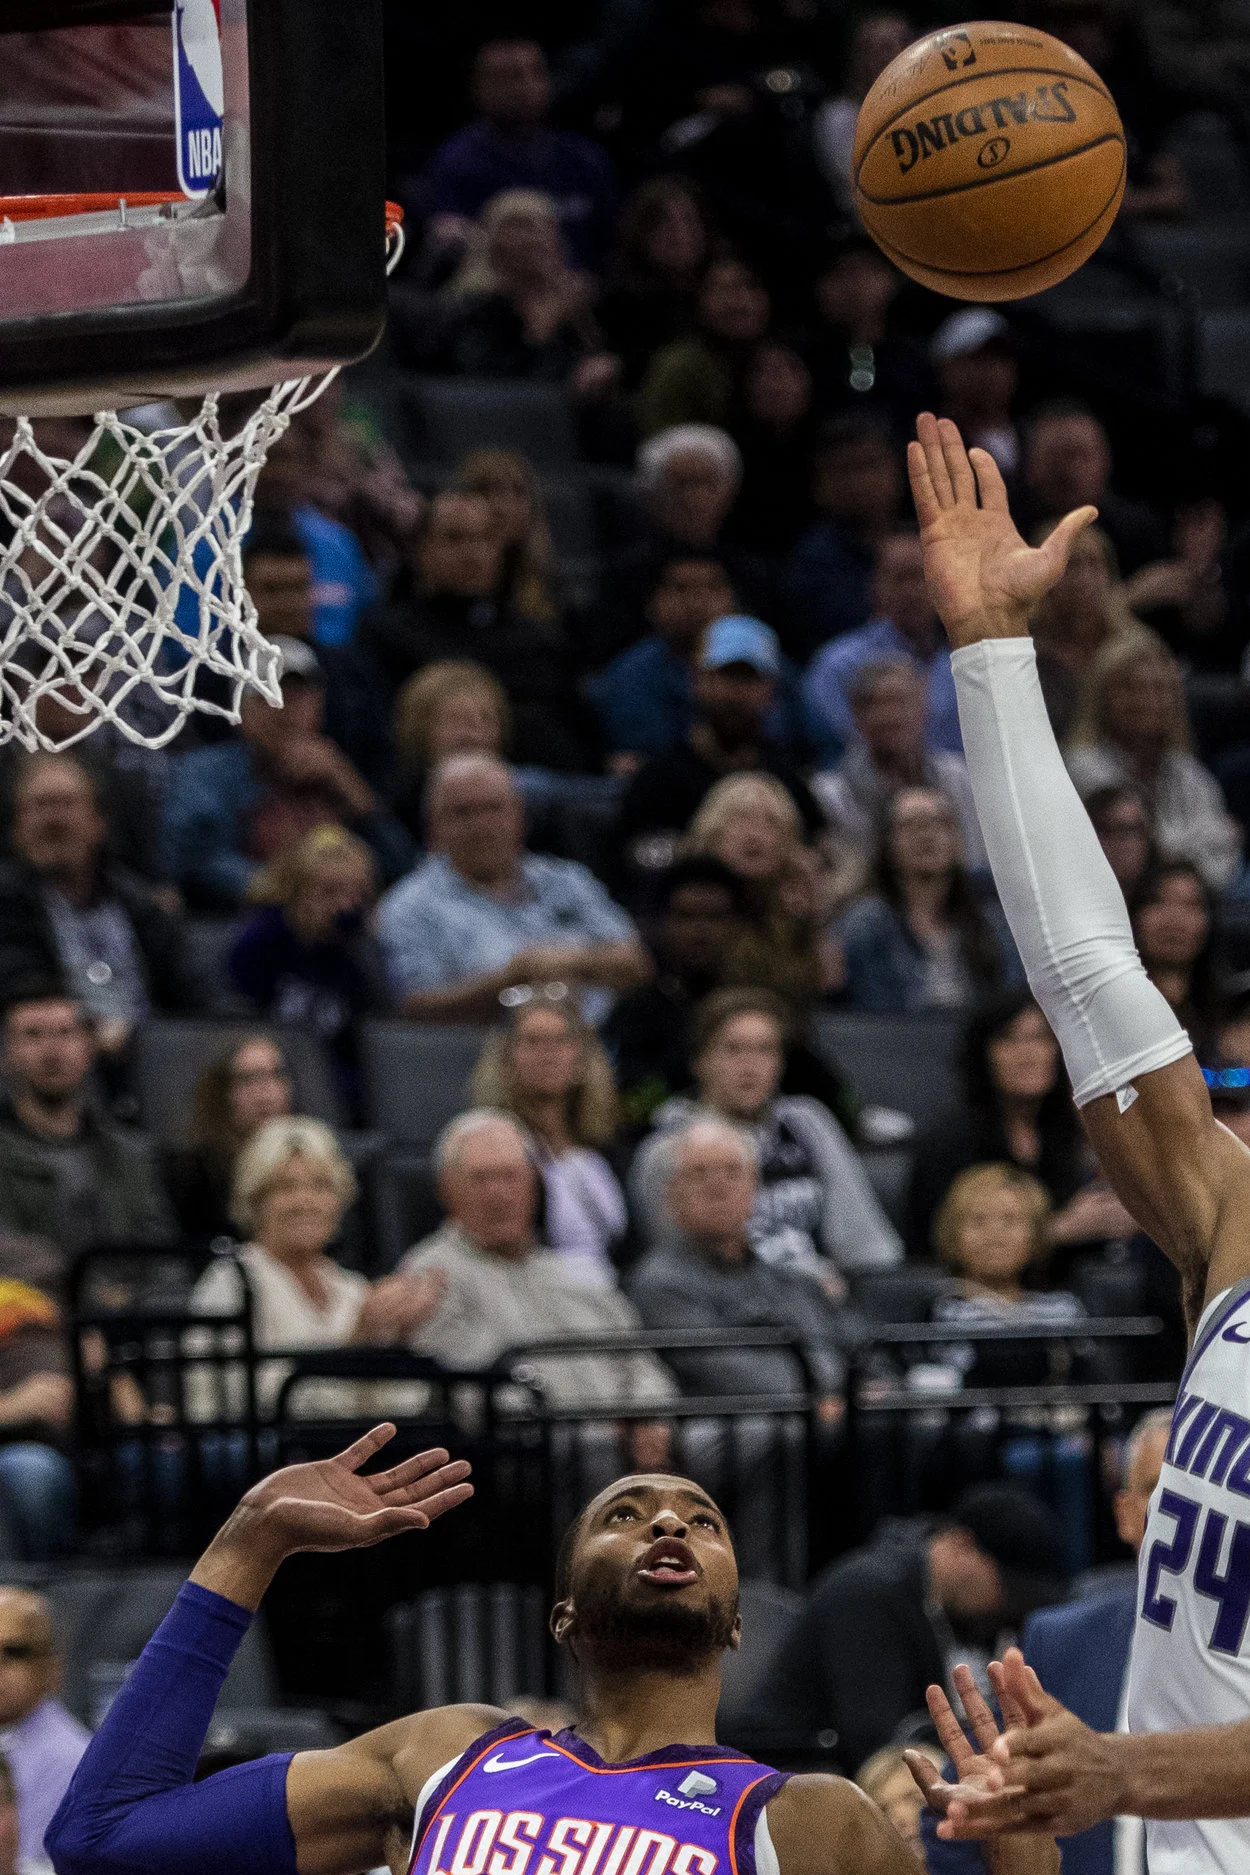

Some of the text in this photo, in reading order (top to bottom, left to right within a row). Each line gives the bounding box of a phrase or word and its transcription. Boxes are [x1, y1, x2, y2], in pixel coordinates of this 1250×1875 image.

[188, 127, 222, 178] NBA
[888, 82, 1077, 174] SPALDING
[655, 1789, 721, 1816] PayPal
